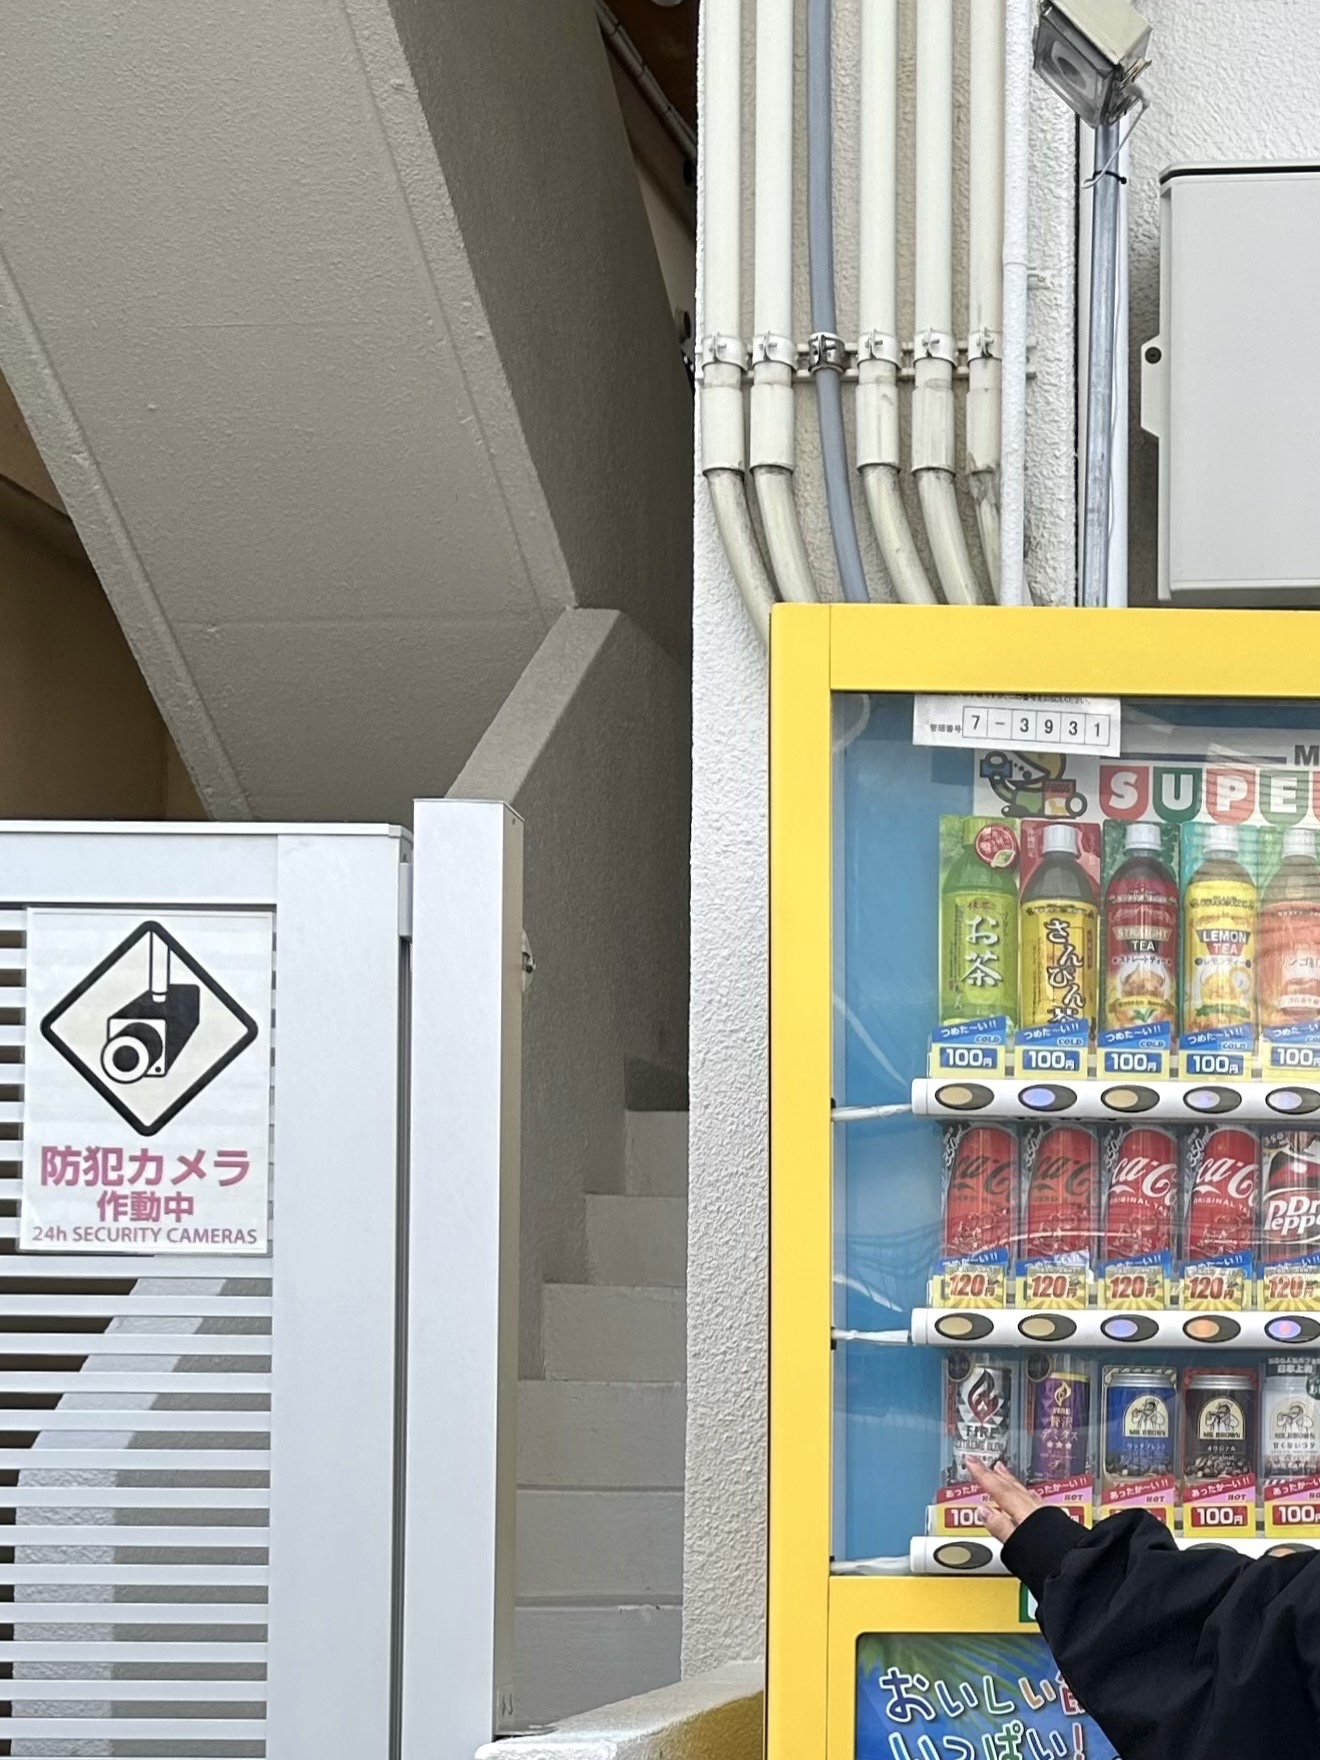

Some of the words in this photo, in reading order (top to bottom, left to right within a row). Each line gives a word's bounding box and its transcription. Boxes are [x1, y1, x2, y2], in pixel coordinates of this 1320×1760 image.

[1131, 940, 1156, 952] TEA
[1202, 930, 1248, 943] LEMON
[962, 914, 1003, 987] お茶
[1212, 943, 1239, 955] TEA
[946, 1048, 993, 1068] 100円
[1028, 1050, 1075, 1070] 100円
[1111, 1053, 1158, 1073] 100円
[1192, 1055, 1239, 1075] 100円
[40, 1145, 252, 1188] 防犯カメラ
[96, 1190, 195, 1223] 作動中
[32, 1226, 67, 1242] 24h
[72, 1227, 162, 1244] SECURITY
[166, 1228, 258, 1245] CAMERAS
[966, 1425, 998, 1439] FIRE
[1196, 1508, 1244, 1525] 100円
